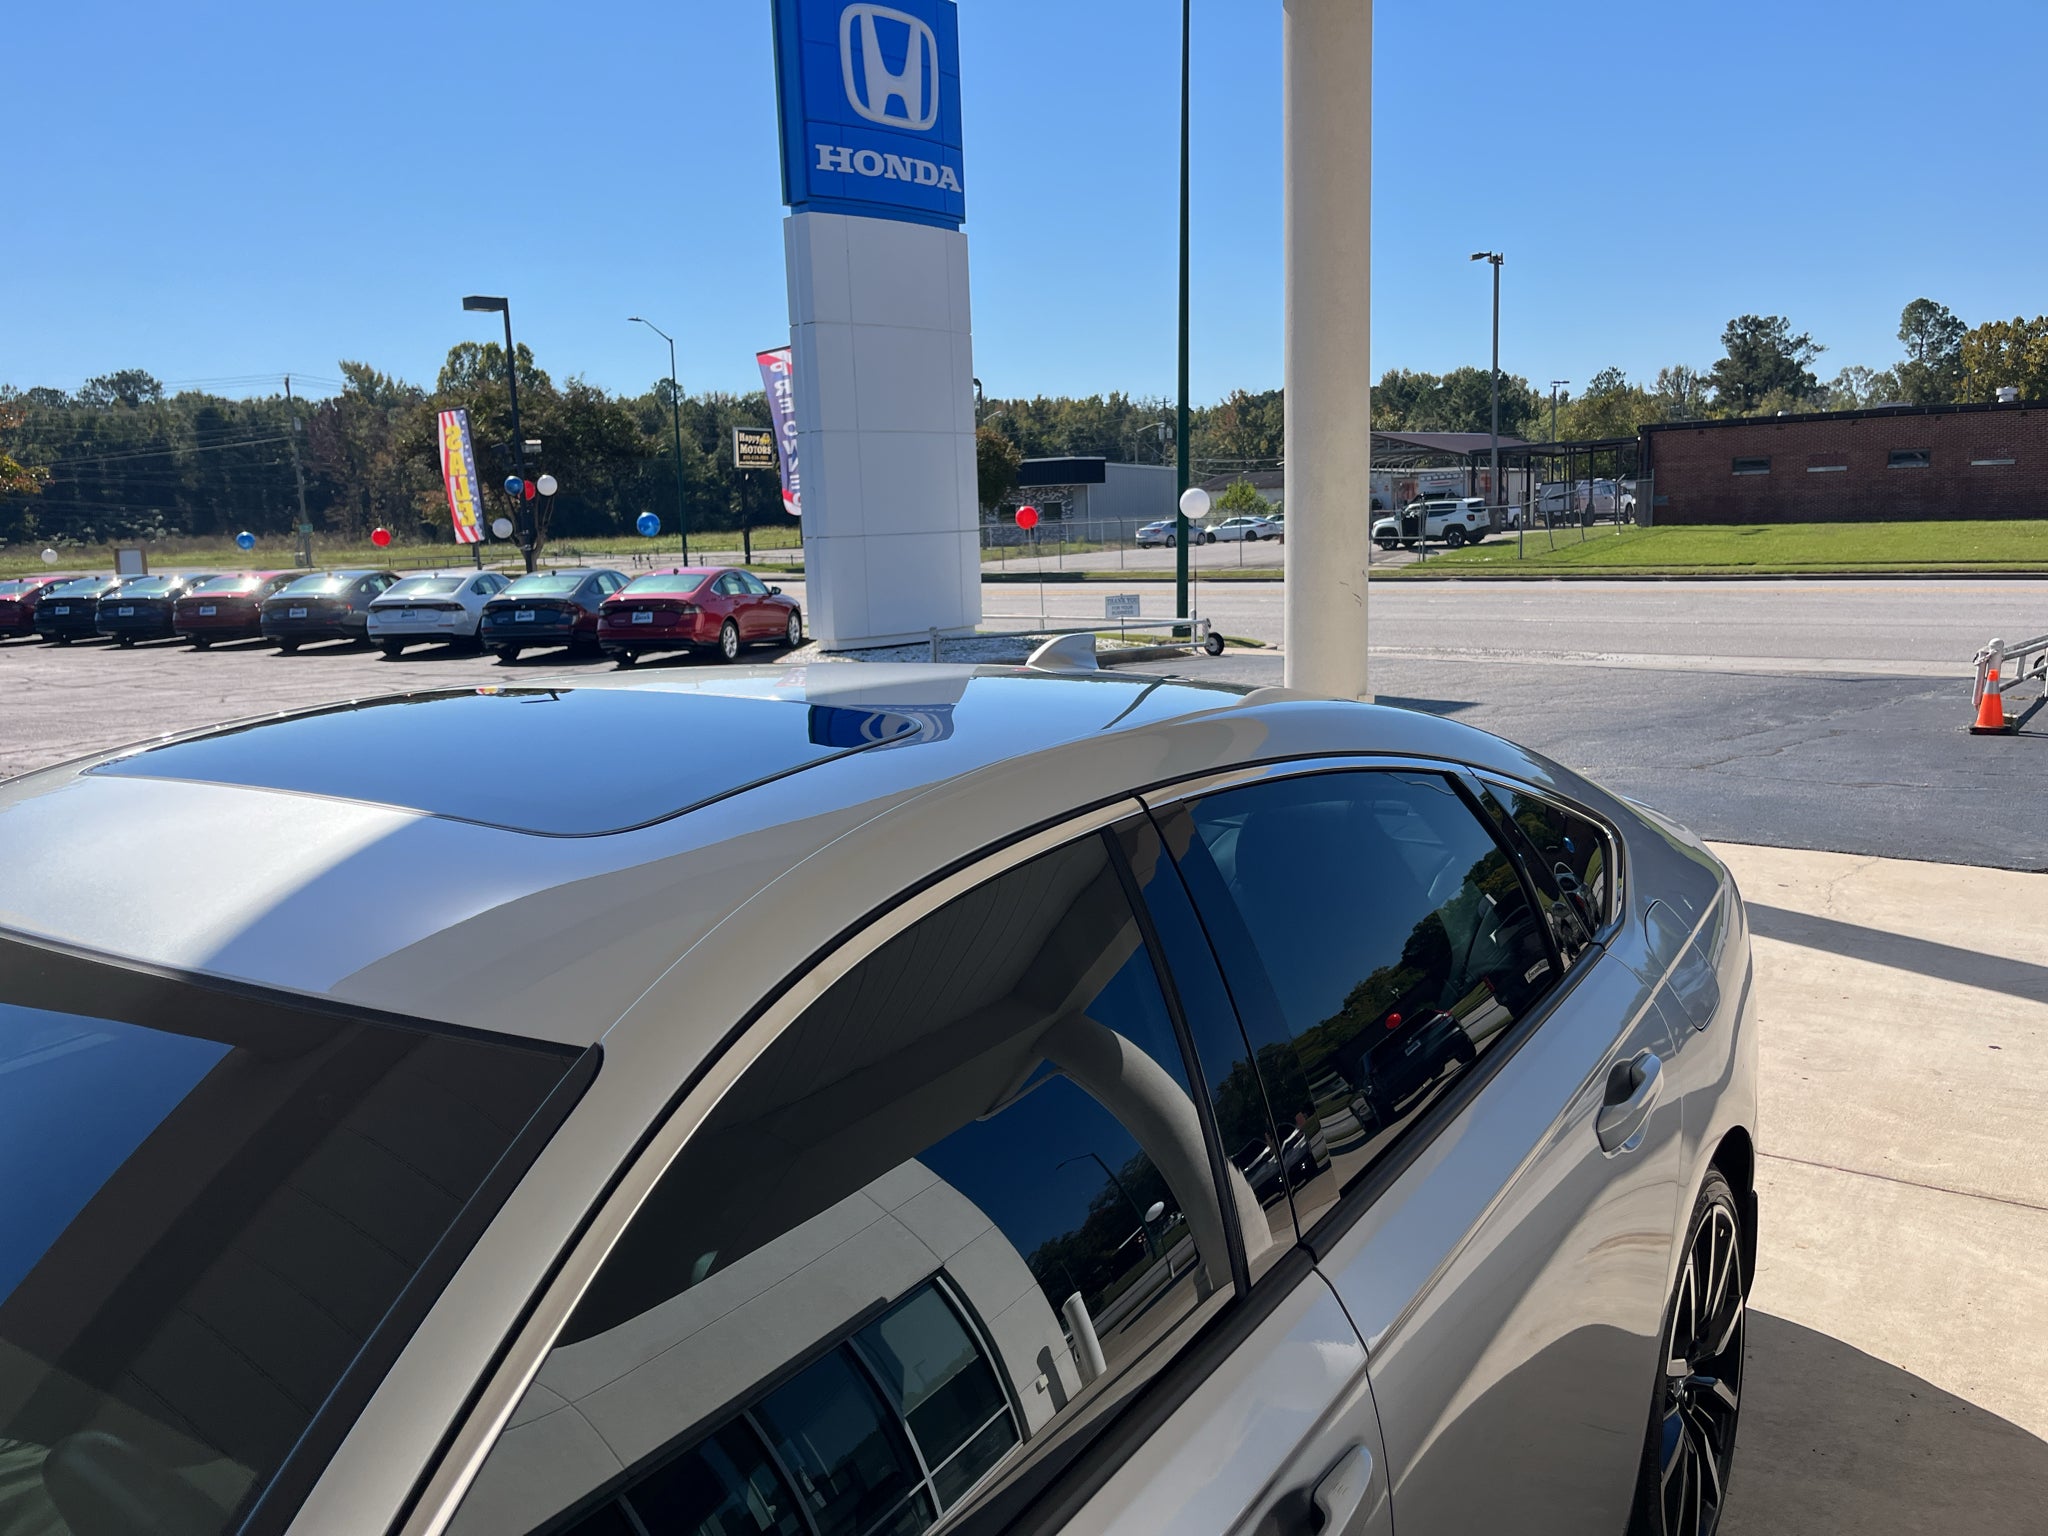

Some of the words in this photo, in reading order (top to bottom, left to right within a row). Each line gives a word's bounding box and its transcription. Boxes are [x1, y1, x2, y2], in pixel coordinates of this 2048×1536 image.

[815, 144, 962, 192] HONDA
[739, 432, 760, 444] Happy
[740, 444, 772, 455] MOTORS
